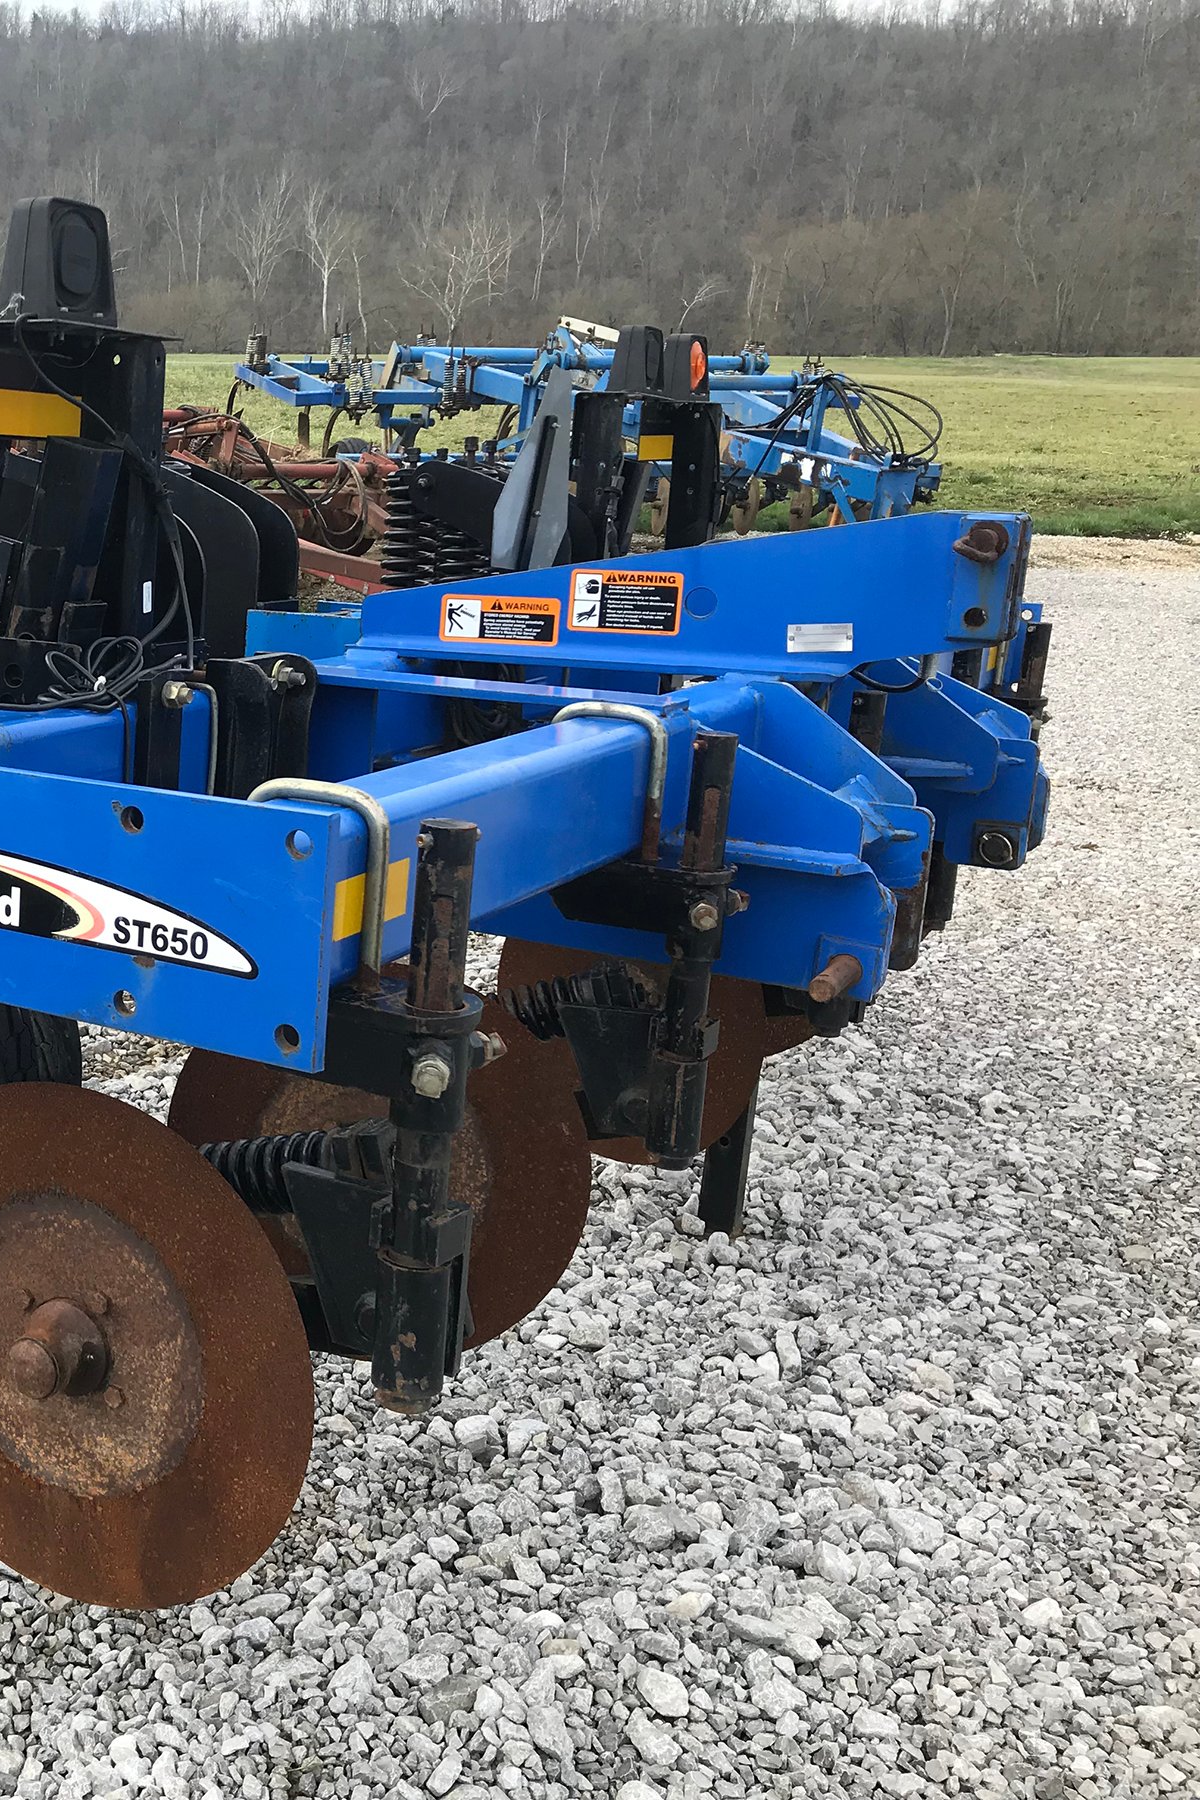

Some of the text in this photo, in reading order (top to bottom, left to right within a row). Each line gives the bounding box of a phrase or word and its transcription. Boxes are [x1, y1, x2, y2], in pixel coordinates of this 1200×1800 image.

[618, 574, 676, 584] WARNING
[505, 602, 550, 612] WARNING
[113, 916, 209, 960] ST650
